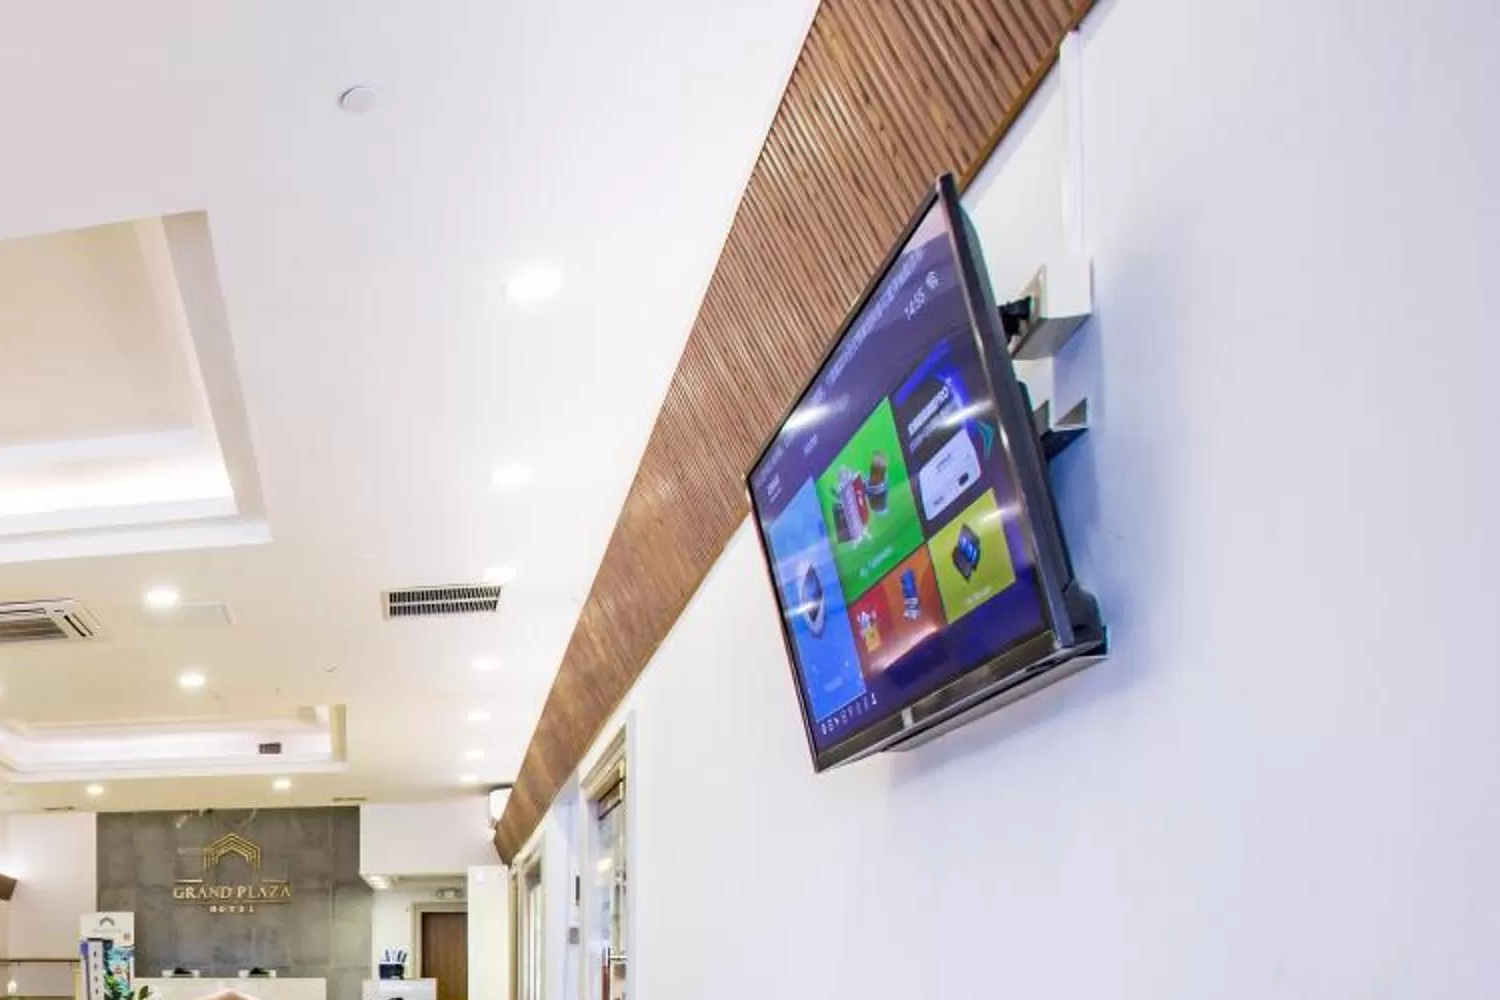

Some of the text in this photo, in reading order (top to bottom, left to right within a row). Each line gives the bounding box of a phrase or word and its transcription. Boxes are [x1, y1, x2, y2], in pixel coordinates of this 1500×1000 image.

[173, 885, 292, 899] GRAND PLAZA
[209, 904, 255, 913] HOTEL
